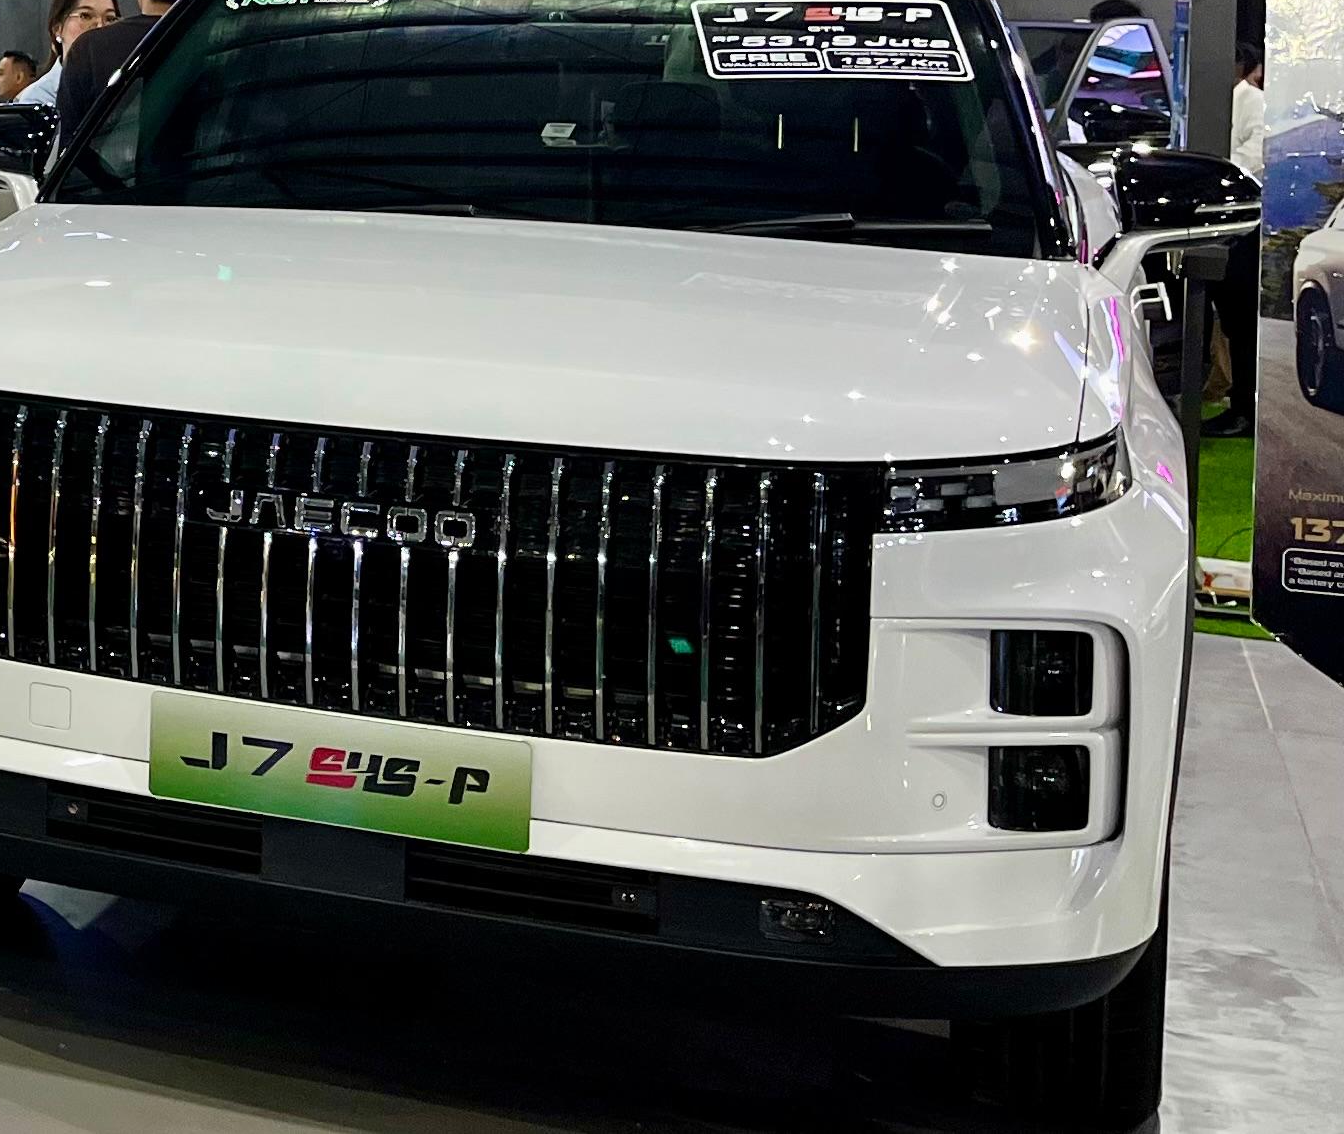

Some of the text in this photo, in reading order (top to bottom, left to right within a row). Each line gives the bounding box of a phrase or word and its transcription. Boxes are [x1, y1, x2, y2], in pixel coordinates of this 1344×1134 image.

[864, 36, 950, 49] Juta
[206, 489, 476, 548] JAECOO
[180, 732, 294, 776] J7
